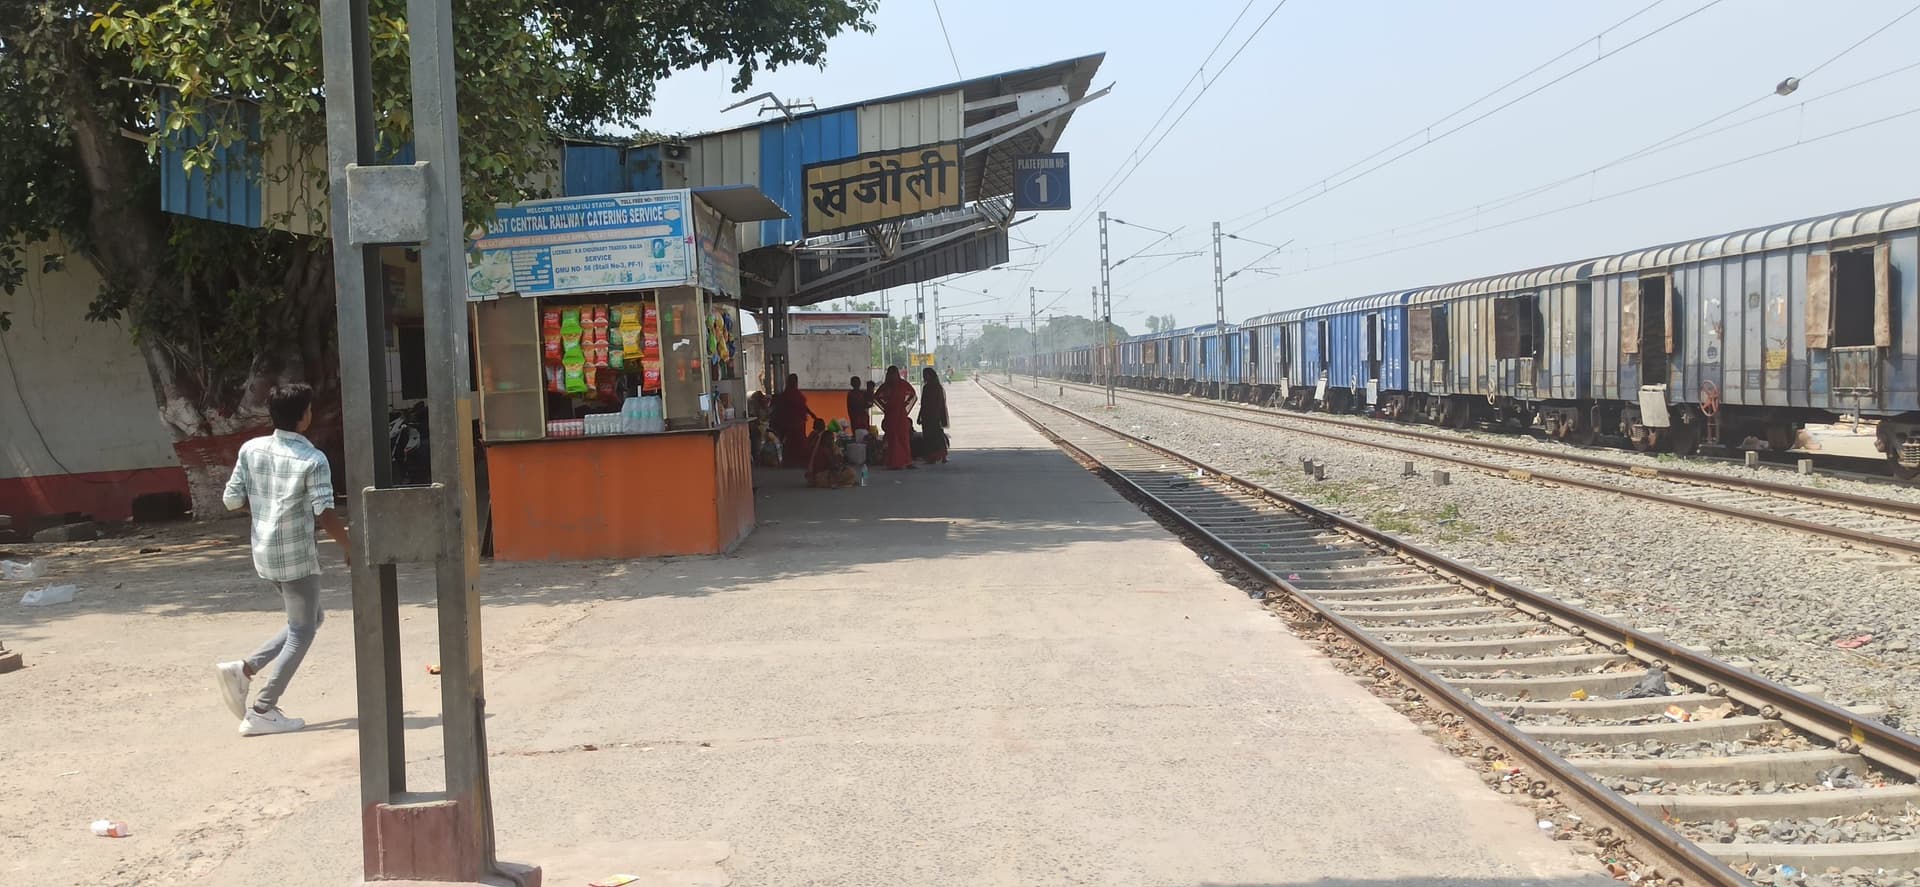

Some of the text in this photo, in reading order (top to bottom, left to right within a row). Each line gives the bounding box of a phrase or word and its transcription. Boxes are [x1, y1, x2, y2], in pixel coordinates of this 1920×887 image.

[809, 150, 956, 218] खजोली
[1035, 174, 1048, 202] 1
[487, 218, 509, 234] EAST
[511, 216, 548, 232] CENTRAL
[550, 212, 585, 229] RAILWAY
[587, 209, 627, 226] CATERING
[630, 206, 663, 222] SERVICE
[526, 206, 553, 214] WELCOME
[591, 201, 616, 209] STATION
[585, 254, 612, 263] SERVICE
